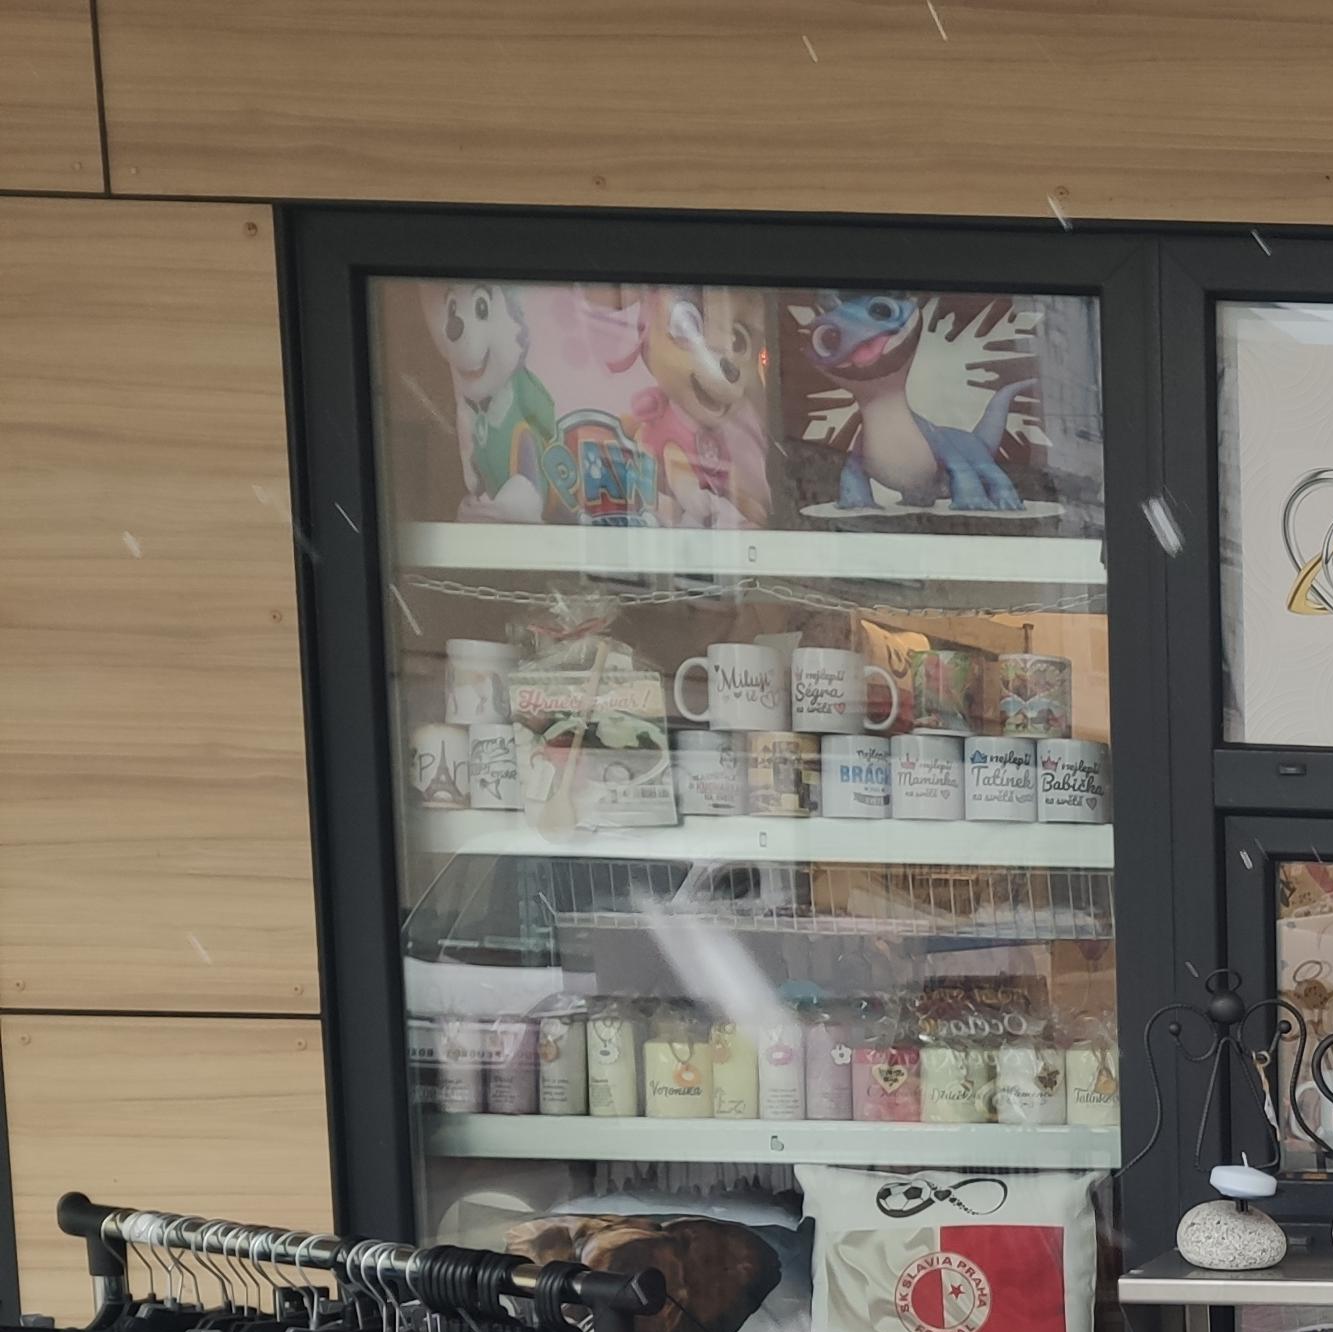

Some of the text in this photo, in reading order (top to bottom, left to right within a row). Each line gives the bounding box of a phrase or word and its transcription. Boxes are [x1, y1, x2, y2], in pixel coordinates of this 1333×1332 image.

[795, 683, 844, 707] Ségra
[971, 765, 1036, 790] Tatínek
[1041, 772, 1104, 798] Babička
[903, 1256, 953, 1291] SLAVIA
[957, 1260, 987, 1309] PRAHA
